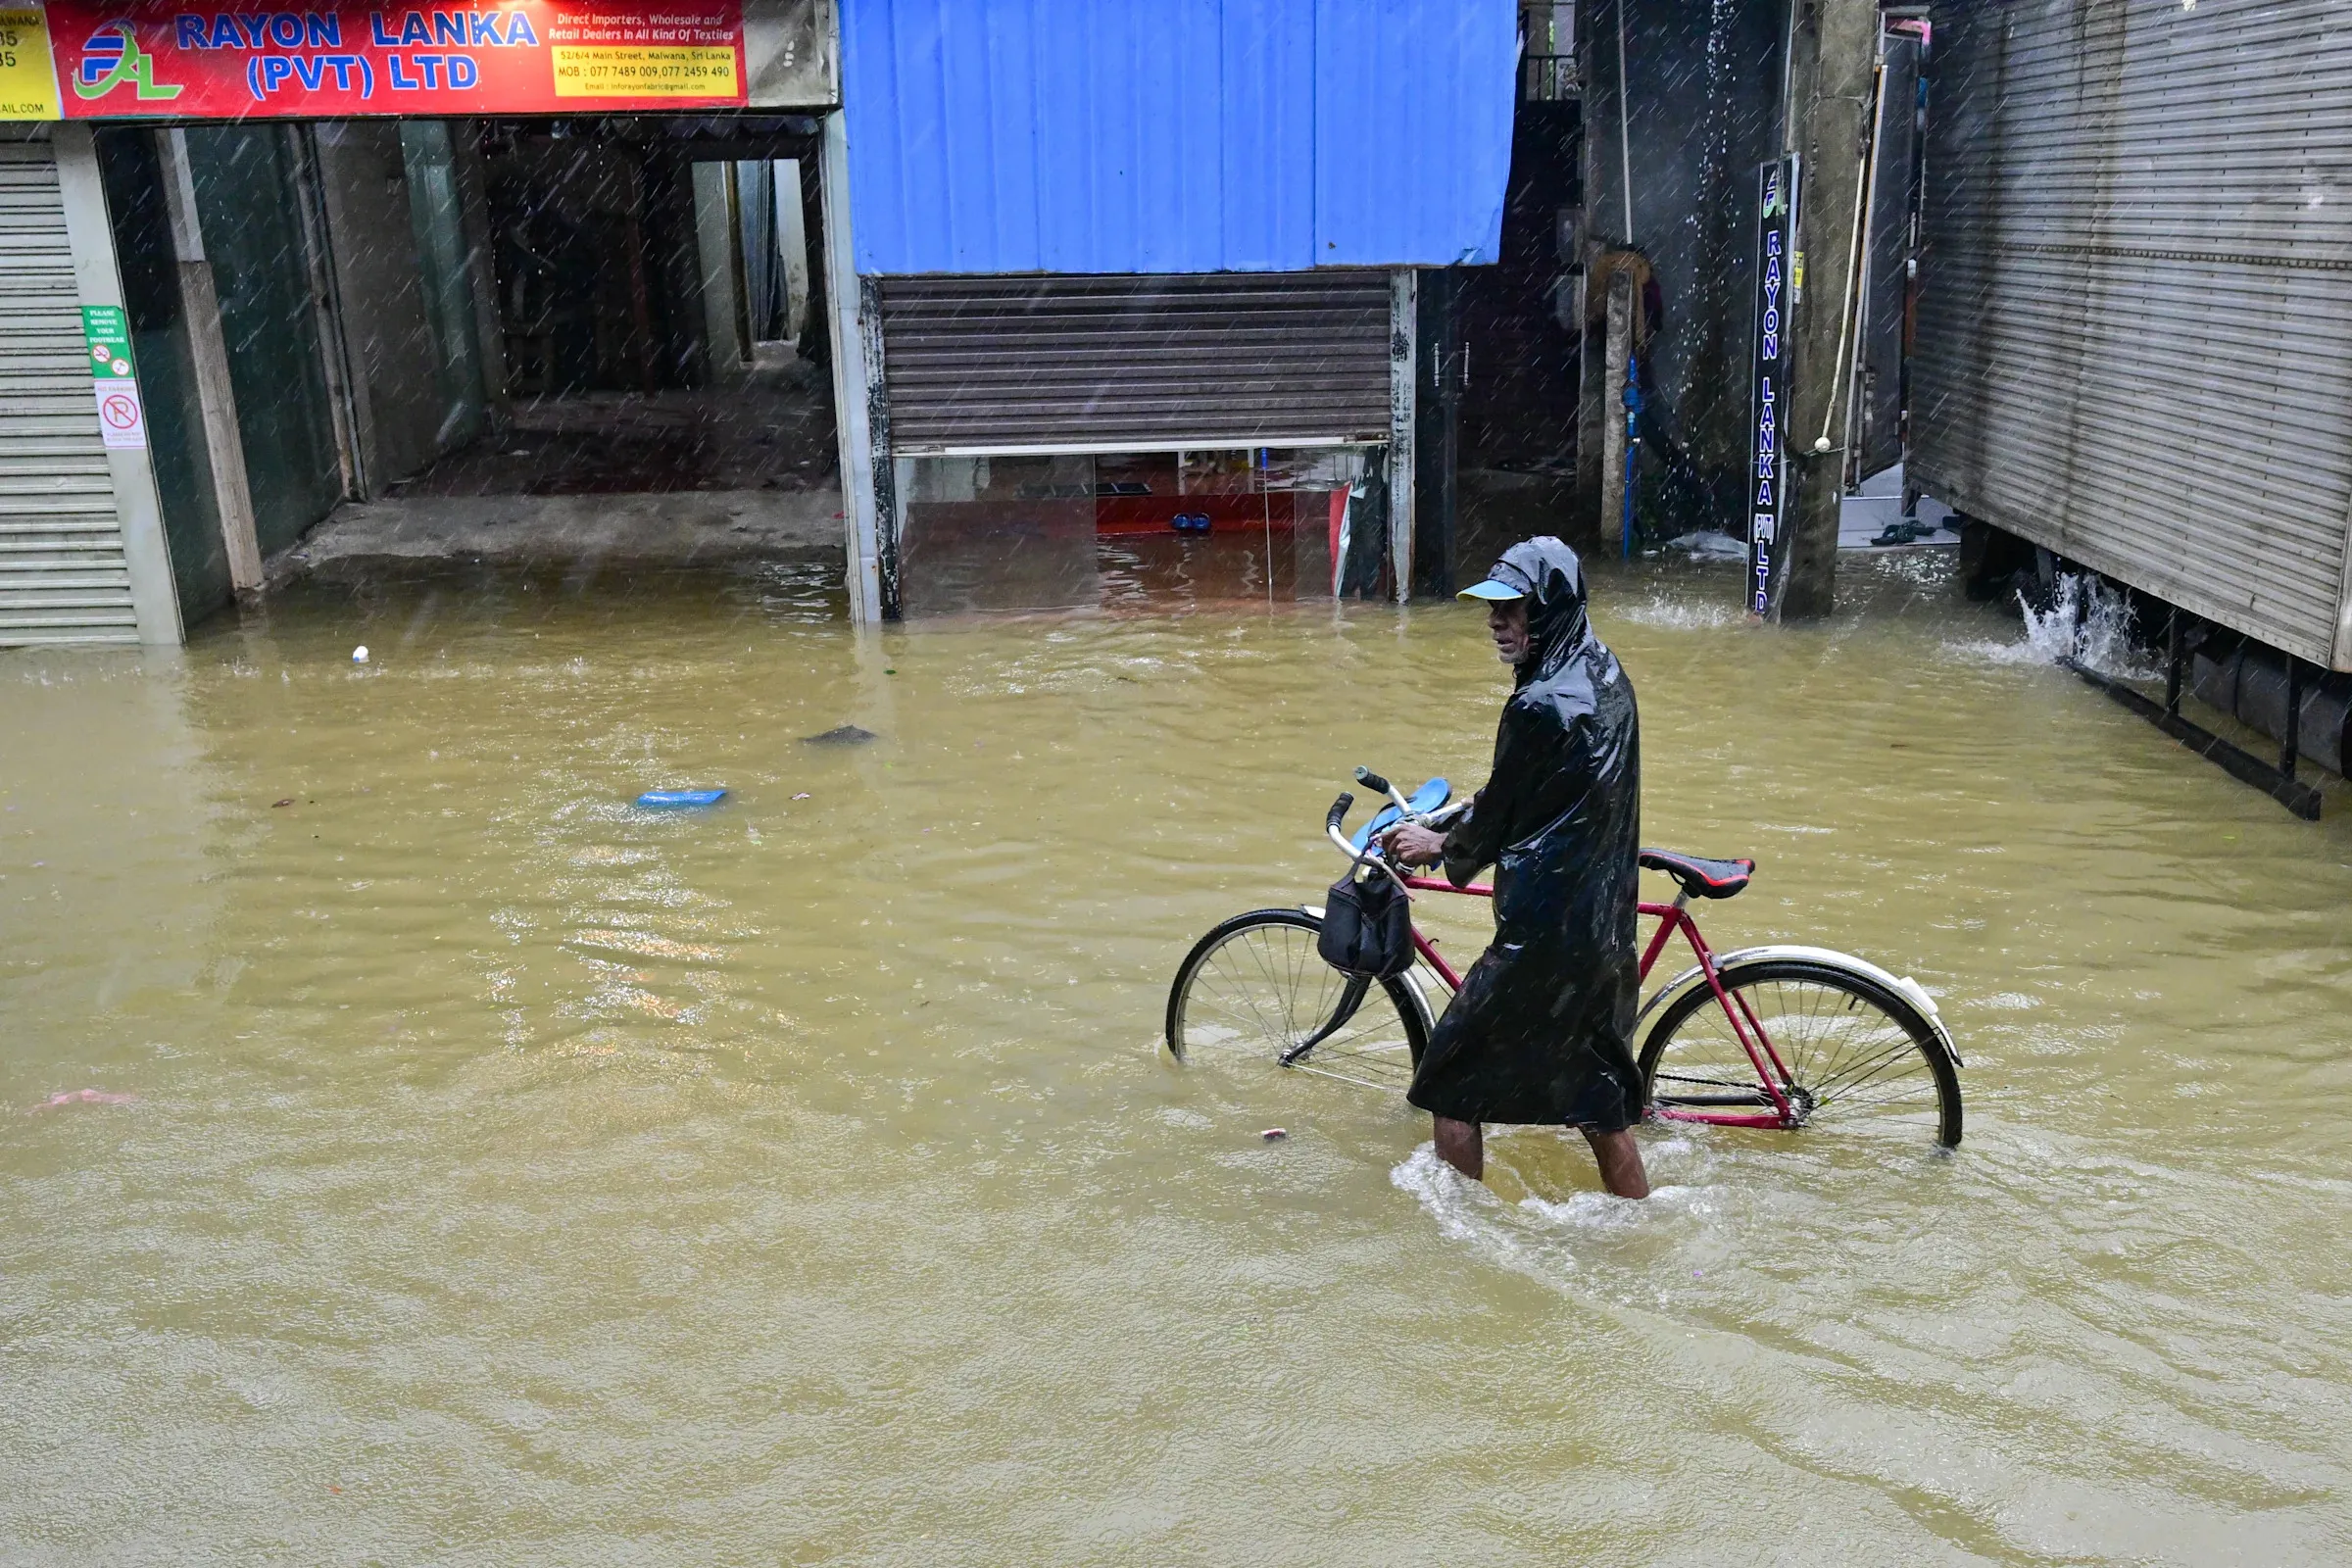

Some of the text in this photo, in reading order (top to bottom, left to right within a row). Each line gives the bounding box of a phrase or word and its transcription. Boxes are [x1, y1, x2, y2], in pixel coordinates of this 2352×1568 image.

[0, 16, 39, 25] LWANA
[174, 11, 539, 49] RAYON LANKA
[557, 13, 723, 26] Direct Importers, Wholesale and
[548, 27, 734, 41] Retail Dealers In All Kind Of Textiles
[561, 51, 731, 63] 52/6/4 Main Street, Malwana, Sri Lanka
[246, 54, 478, 100] (PVT) LTD
[558, 66, 581, 77] MOB
[590, 66, 609, 77] 077
[612, 66, 636, 77] 7489
[683, 66, 708, 77] 2459
[710, 66, 730, 77] 490
[1762, 229, 1782, 361] RAYON
[1756, 376, 1775, 506] LANKA
[1754, 538, 1769, 614] LTD
